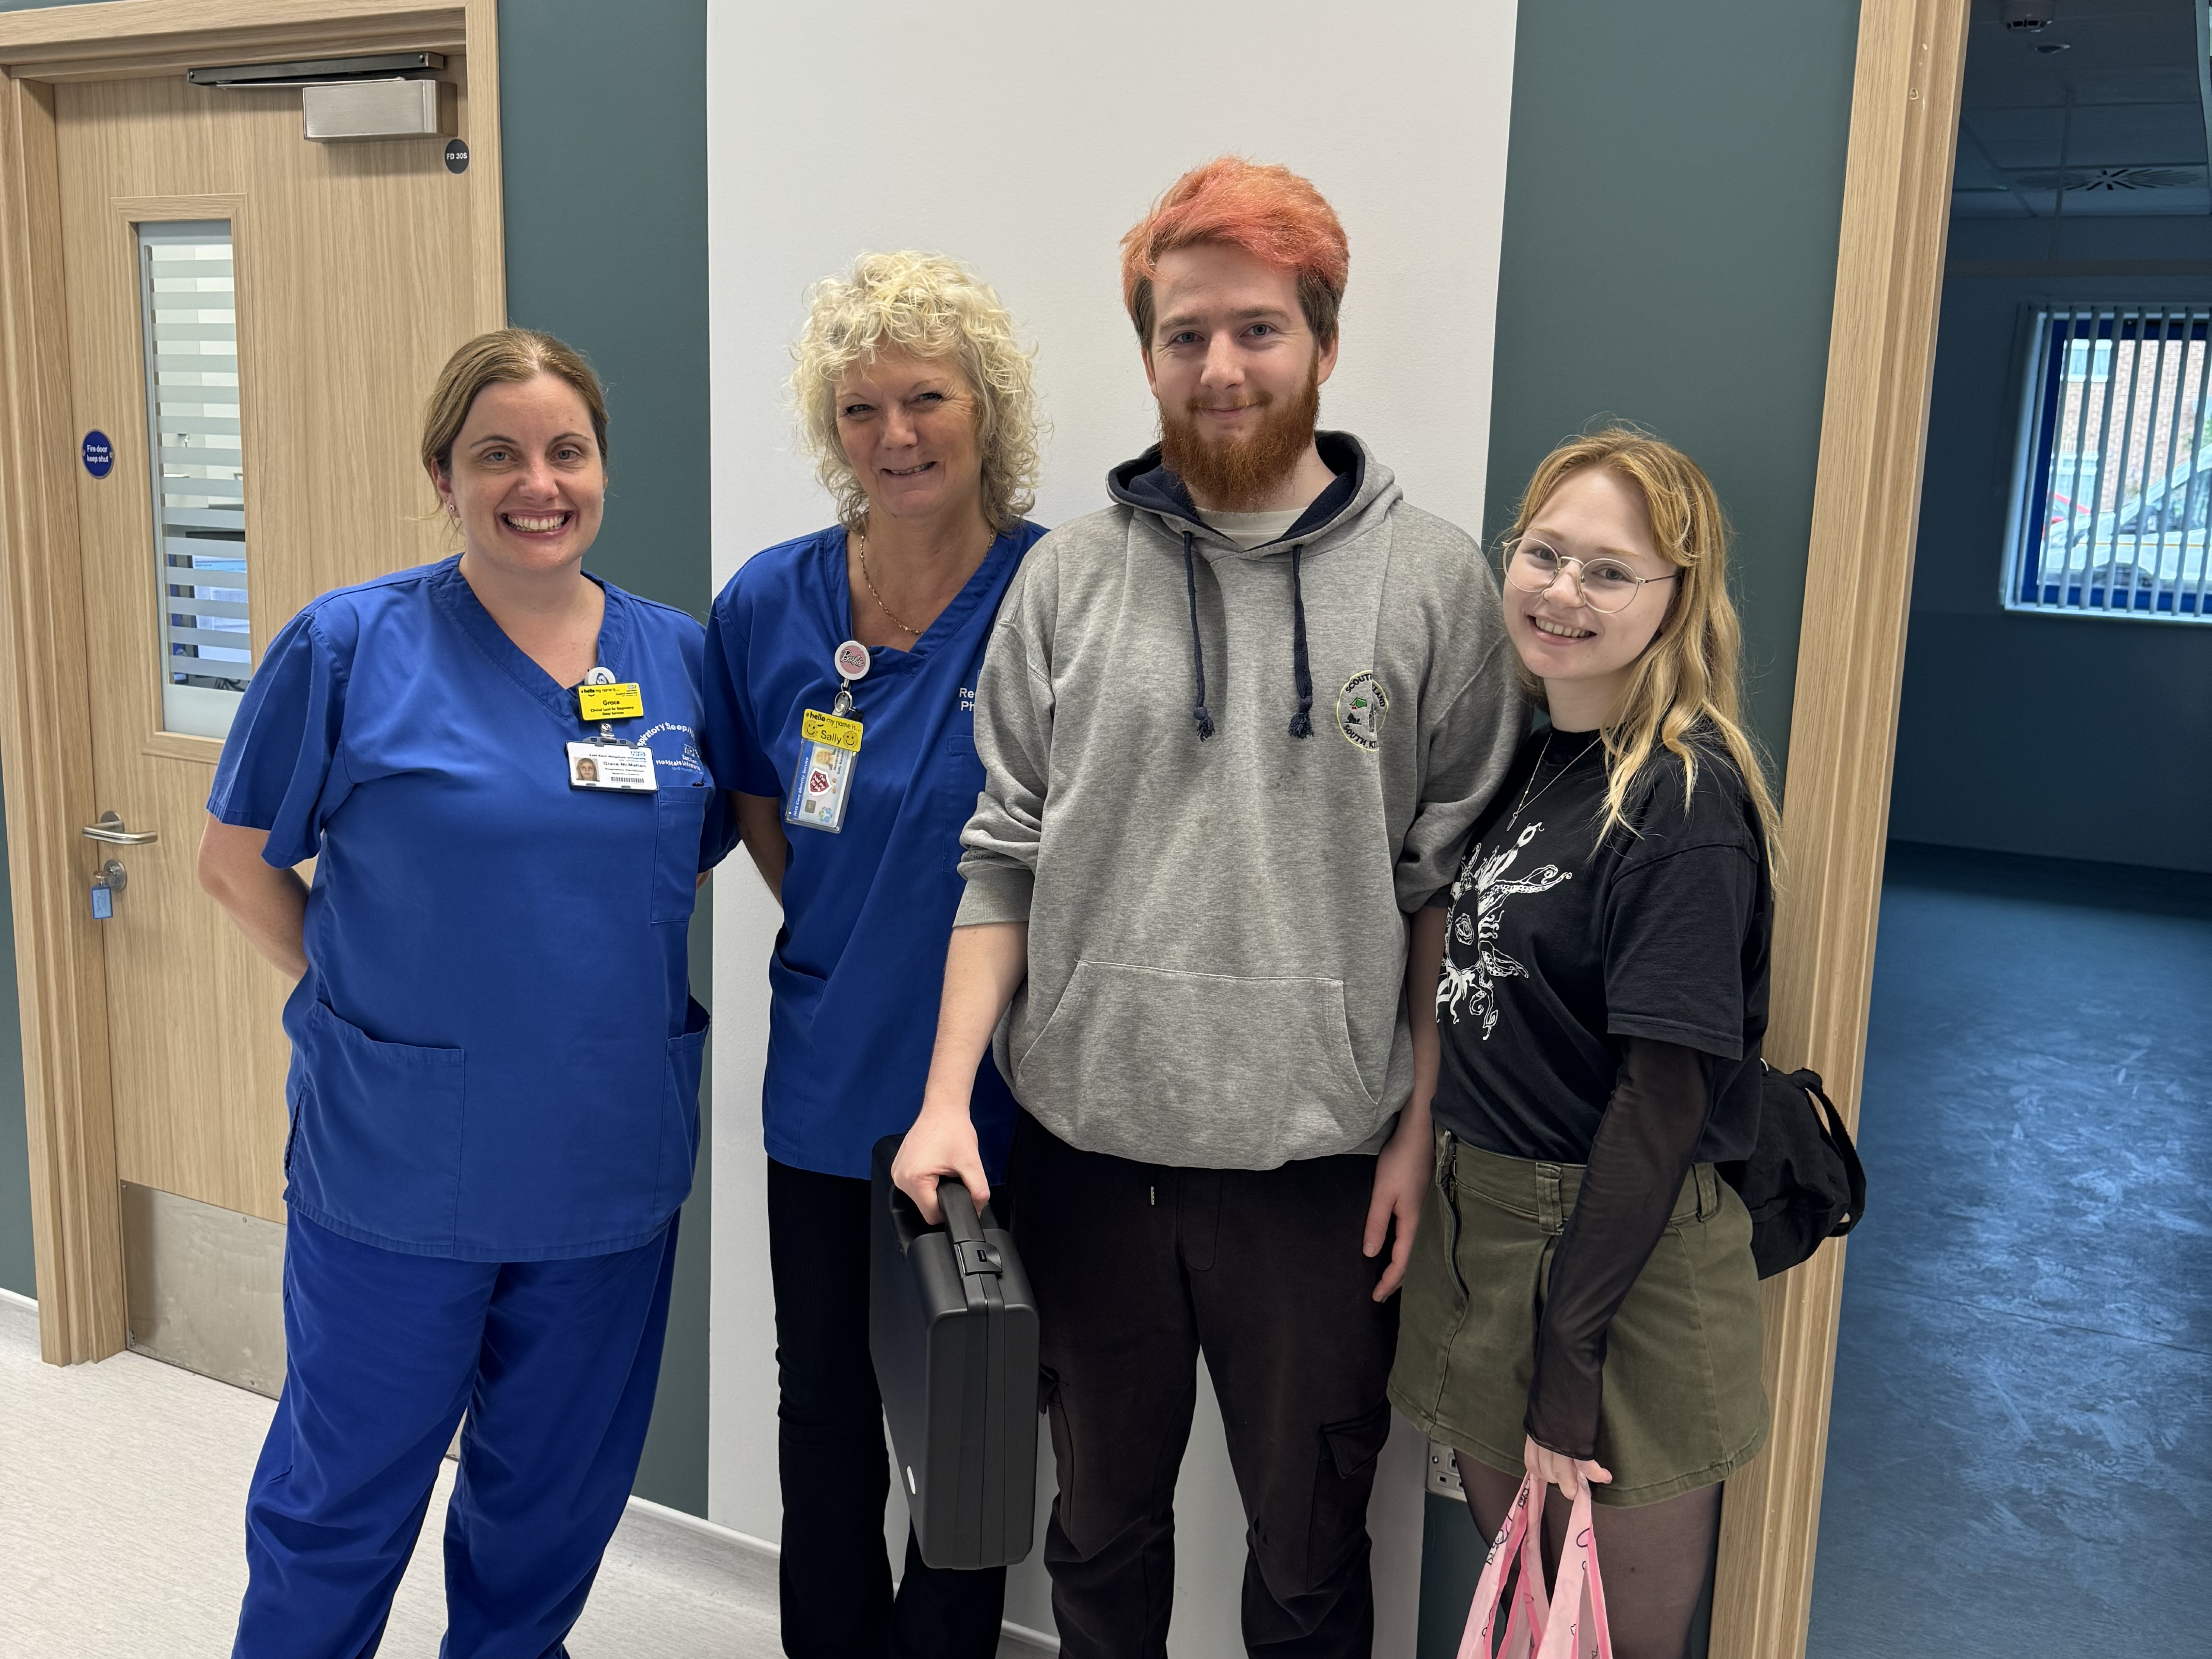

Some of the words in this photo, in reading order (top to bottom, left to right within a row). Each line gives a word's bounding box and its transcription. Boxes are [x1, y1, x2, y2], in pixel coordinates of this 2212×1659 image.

[810, 711, 825, 721] hello
[821, 730, 842, 745] Sally
[1343, 724, 1367, 746] SOUTH
